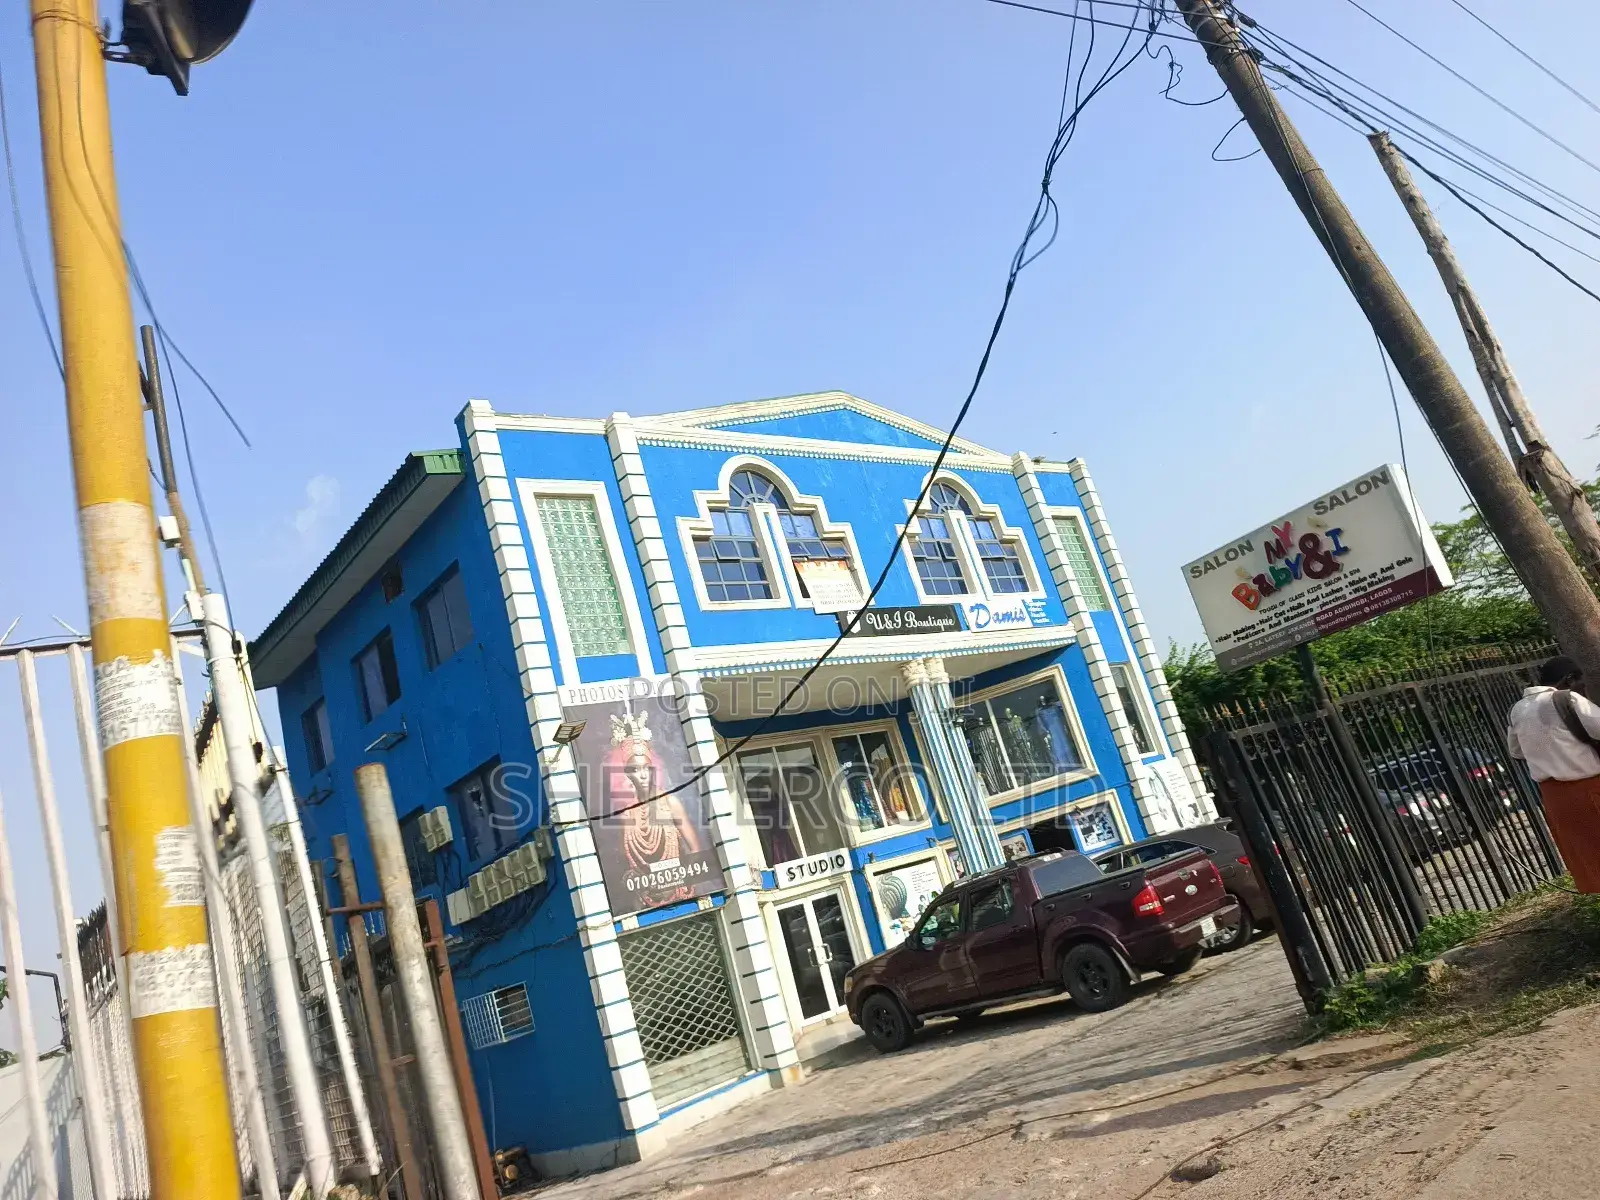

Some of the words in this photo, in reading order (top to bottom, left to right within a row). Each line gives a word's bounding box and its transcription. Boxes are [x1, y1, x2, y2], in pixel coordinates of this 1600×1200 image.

[1313, 471, 1389, 516] SALON
[1264, 521, 1294, 564] MY
[1325, 527, 1350, 556] I
[1190, 540, 1253, 578] SALON
[1232, 623, 1256, 636] Making
[1273, 609, 1286, 617] Cut
[1306, 595, 1320, 603] And
[1320, 585, 1343, 597] Lashes
[1379, 563, 1395, 572] And
[1268, 620, 1281, 628] And
[1352, 584, 1367, 594] Wig
[1366, 573, 1395, 588] Making
[1288, 592, 1305, 601] CLASS
[1307, 585, 1322, 593] KIDS
[1324, 577, 1342, 586] SALON
[1315, 612, 1333, 620] ROAD
[1369, 588, 1392, 599] LAGOS
[905, 610, 955, 632] Boutique
[626, 861, 708, 891] 07026059494
[787, 854, 845, 881] STUDIO
